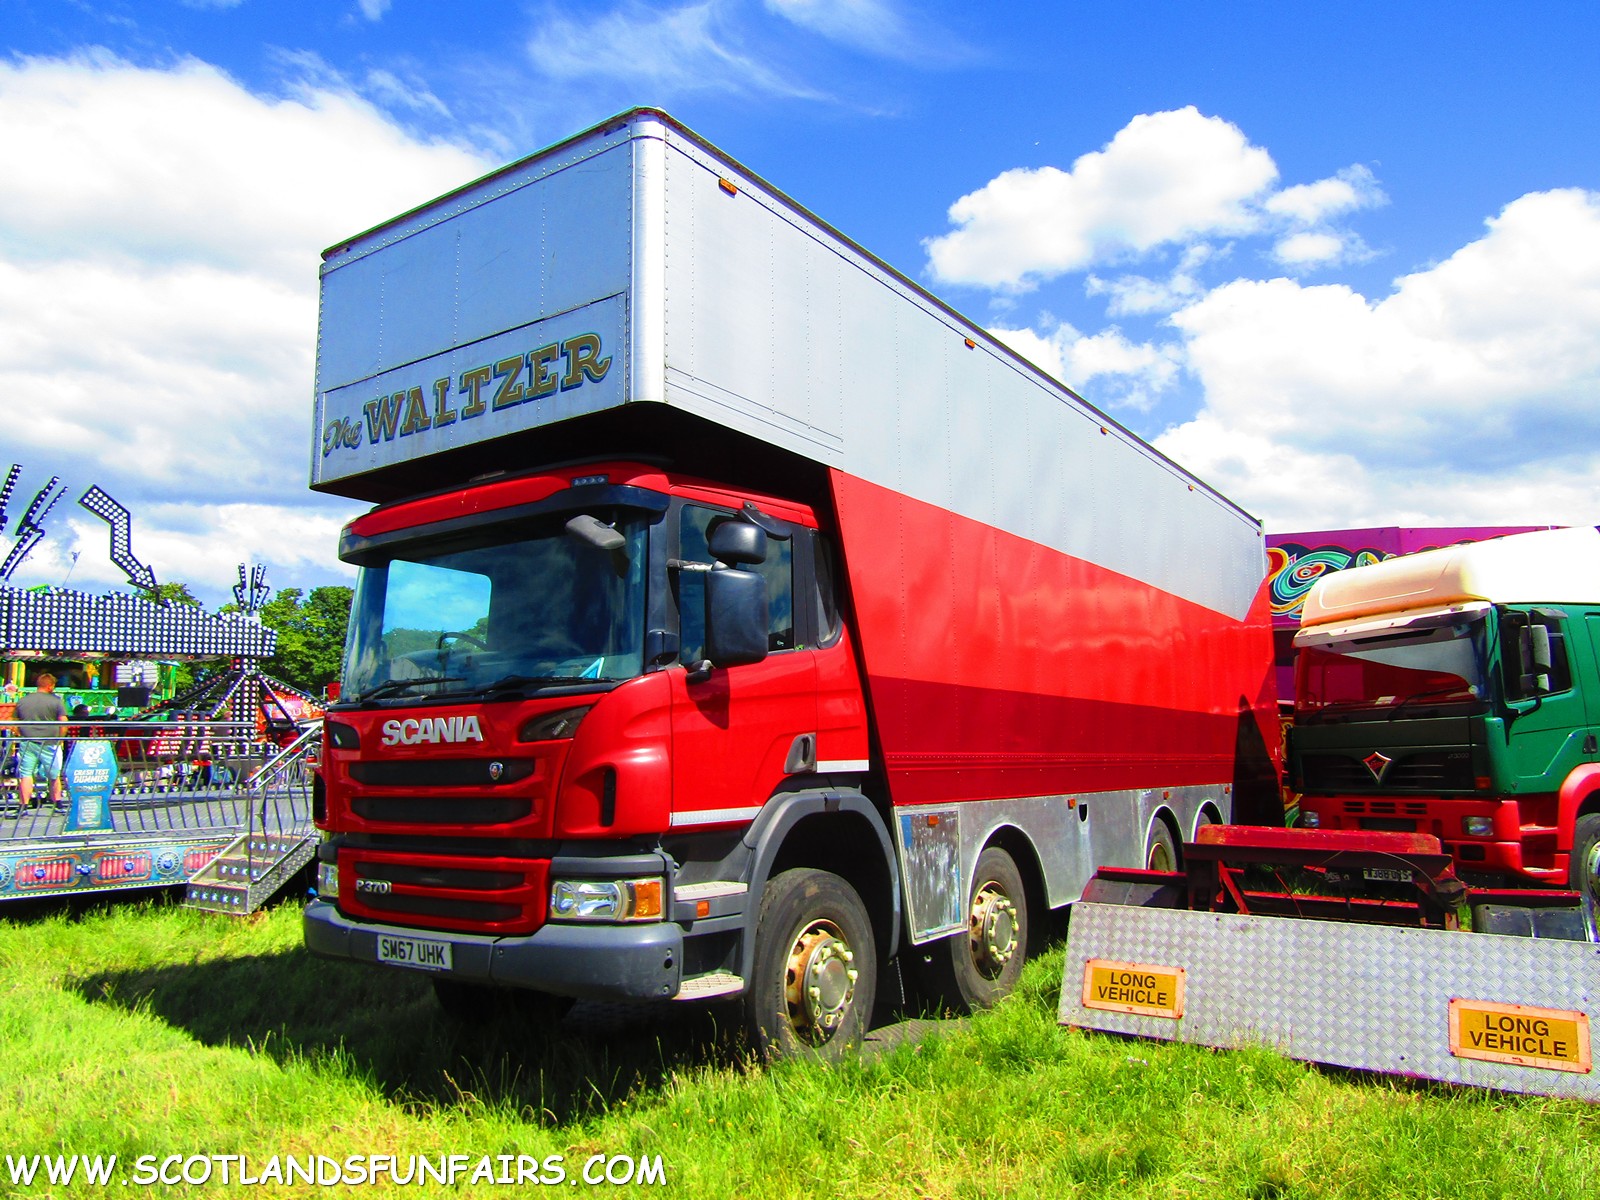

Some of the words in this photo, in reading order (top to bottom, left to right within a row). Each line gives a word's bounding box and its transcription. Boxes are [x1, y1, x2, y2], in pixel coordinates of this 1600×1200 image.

[323, 416, 362, 457] The
[363, 332, 613, 444] WALTZER
[382, 715, 484, 746] SCANIA
[73, 775, 110, 784] DUMMIES
[95, 768, 110, 776] TEST
[382, 938, 414, 961] SM67
[417, 943, 445, 965] UHK
[1110, 971, 1157, 989] LONG
[1098, 985, 1168, 1006] VEHICLE
[1485, 1014, 1550, 1037] LONG
[1469, 1030, 1568, 1058] VEHICLE
